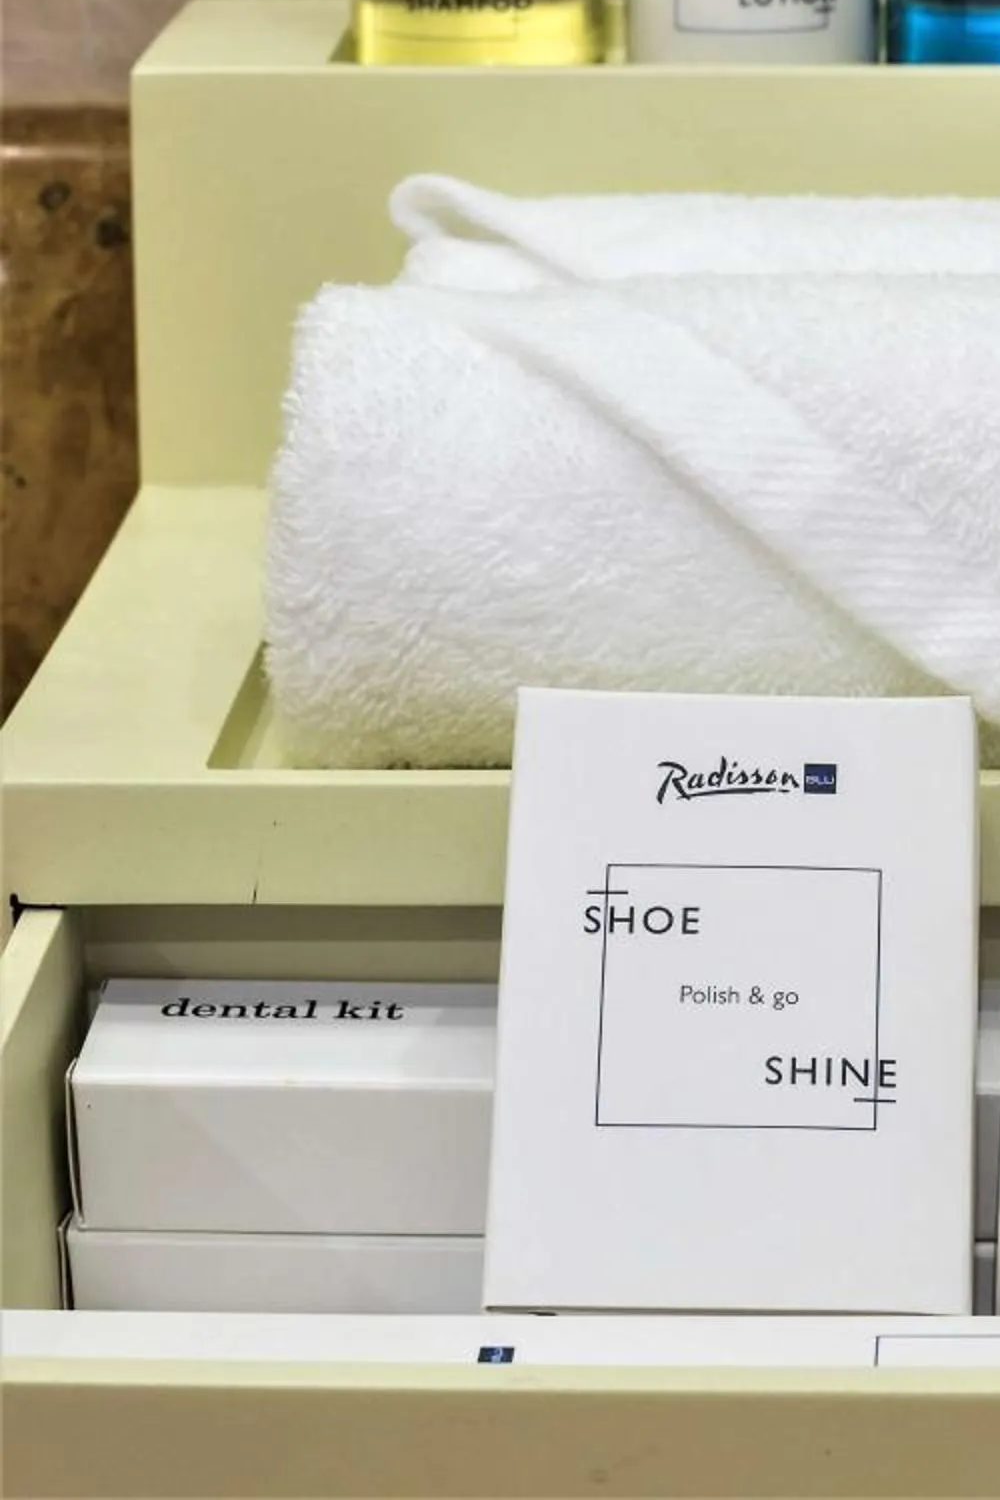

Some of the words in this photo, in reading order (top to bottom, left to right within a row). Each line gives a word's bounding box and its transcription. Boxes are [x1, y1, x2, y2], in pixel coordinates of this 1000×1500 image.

[655, 756, 800, 804] Radisson
[583, 905, 701, 936] SHOE
[161, 998, 317, 1020] dental
[333, 1000, 405, 1021] kit
[679, 985, 741, 1006] Polish
[748, 985, 766, 1006] &
[772, 990, 800, 1011] go
[765, 1056, 898, 1089] SHINE
